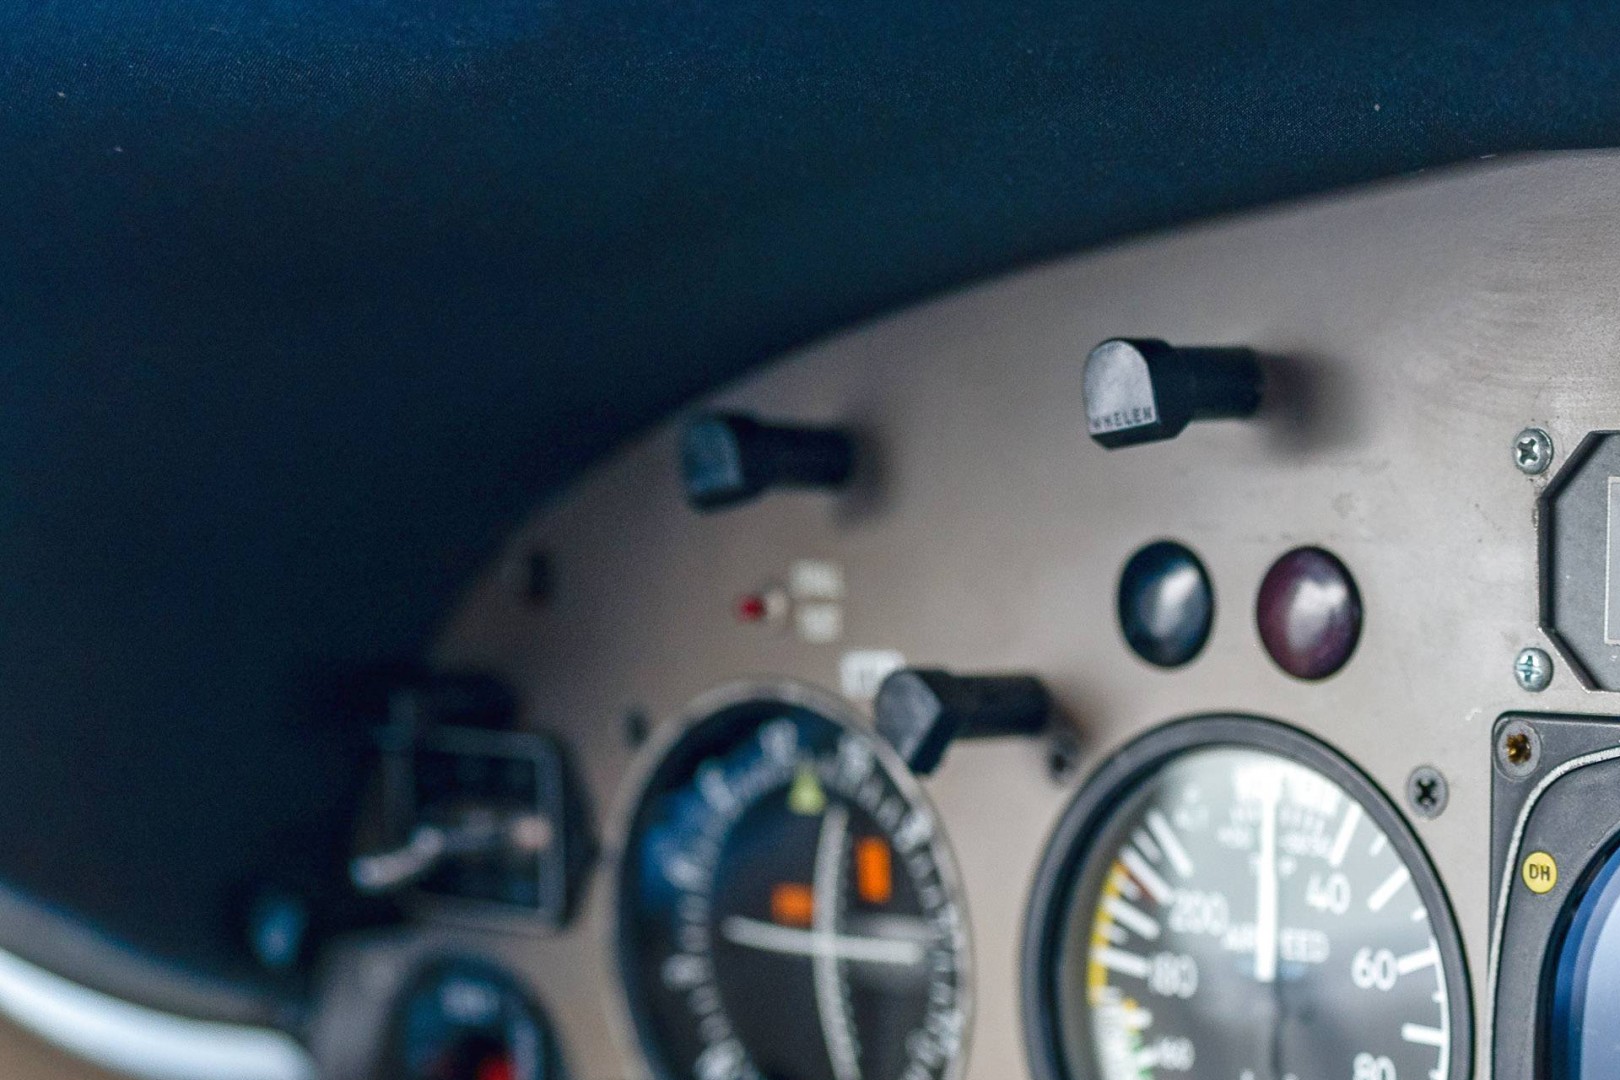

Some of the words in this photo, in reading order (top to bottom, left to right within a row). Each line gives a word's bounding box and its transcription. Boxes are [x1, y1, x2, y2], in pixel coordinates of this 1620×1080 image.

[1305, 871, 1351, 916] 40
[1529, 863, 1551, 881] DH
[1350, 946, 1398, 990] 60
